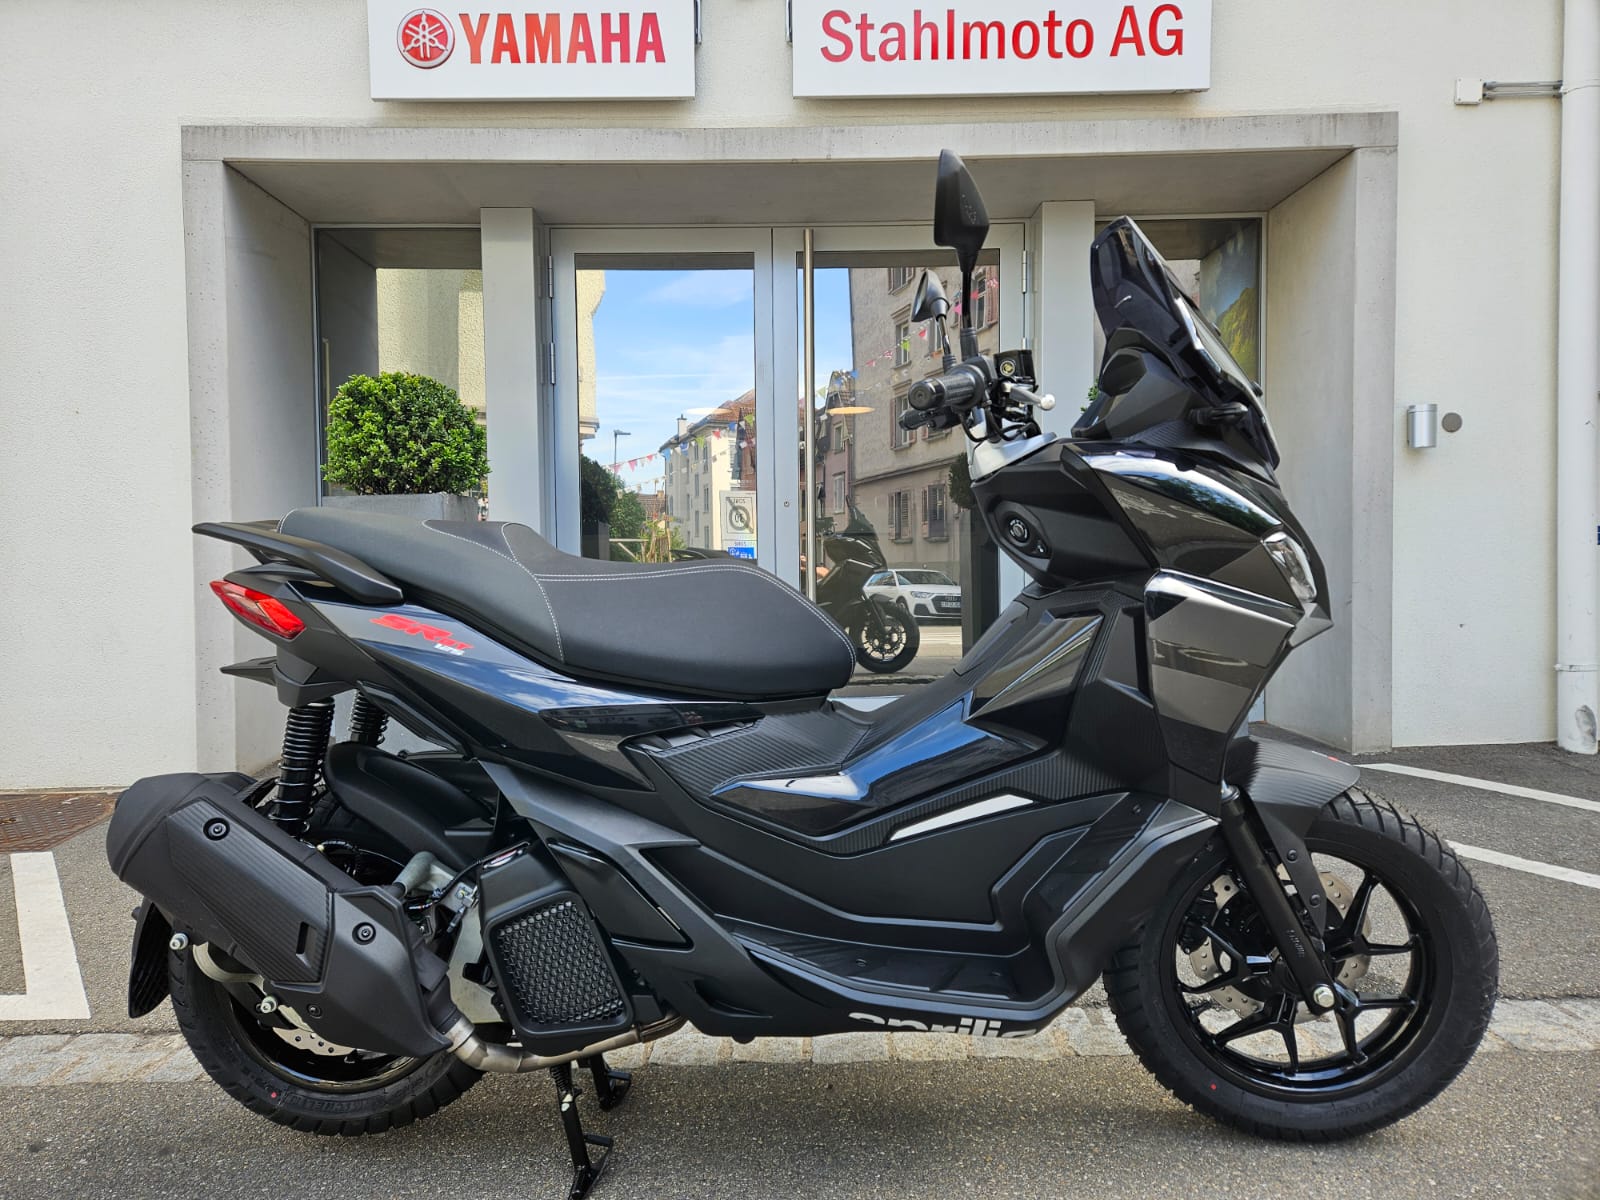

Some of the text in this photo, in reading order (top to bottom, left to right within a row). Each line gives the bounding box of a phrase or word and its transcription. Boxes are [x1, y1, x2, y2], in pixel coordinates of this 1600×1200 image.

[458, 12, 666, 64] YAMAHA
[820, 4, 1184, 63] Stahlmoto AG
